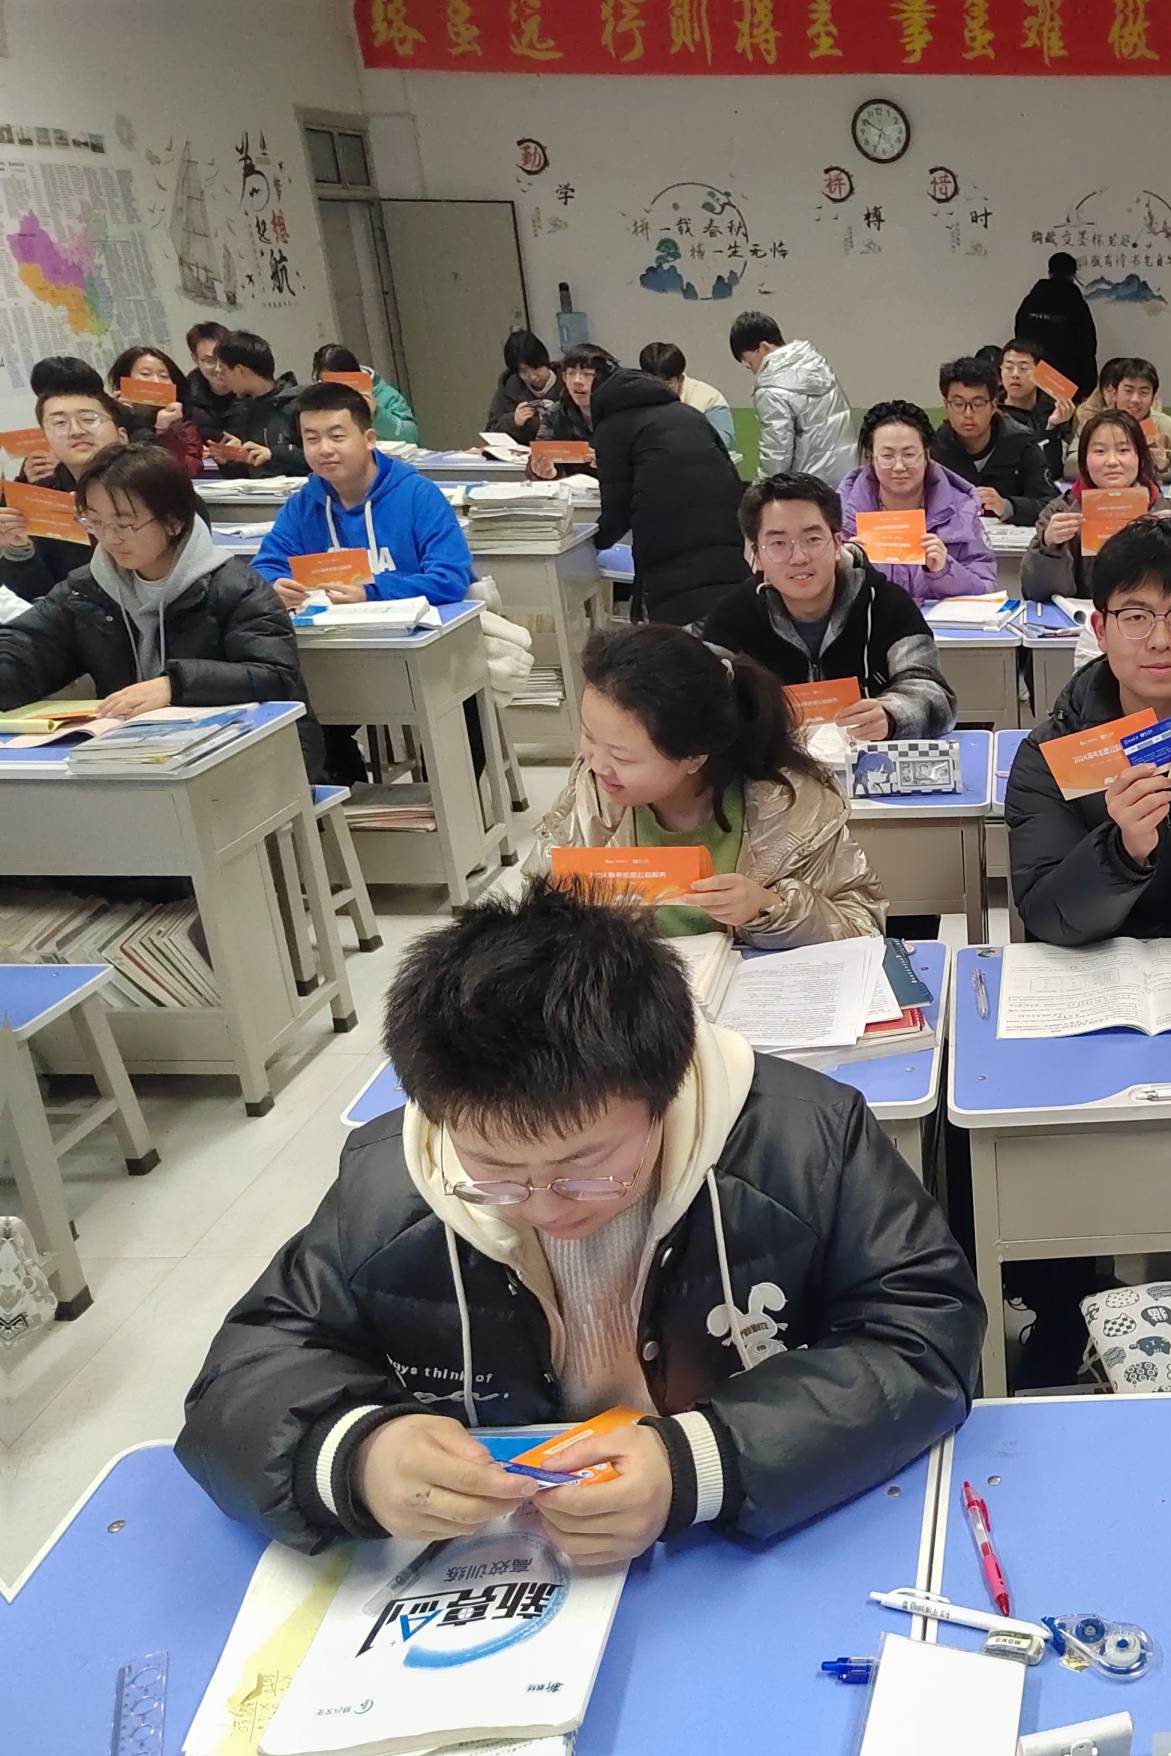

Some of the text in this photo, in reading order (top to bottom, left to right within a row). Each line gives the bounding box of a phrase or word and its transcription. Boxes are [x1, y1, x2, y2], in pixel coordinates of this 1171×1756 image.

[475, 1373, 494, 1384] of
[444, 1557, 534, 1583] 高效训练
